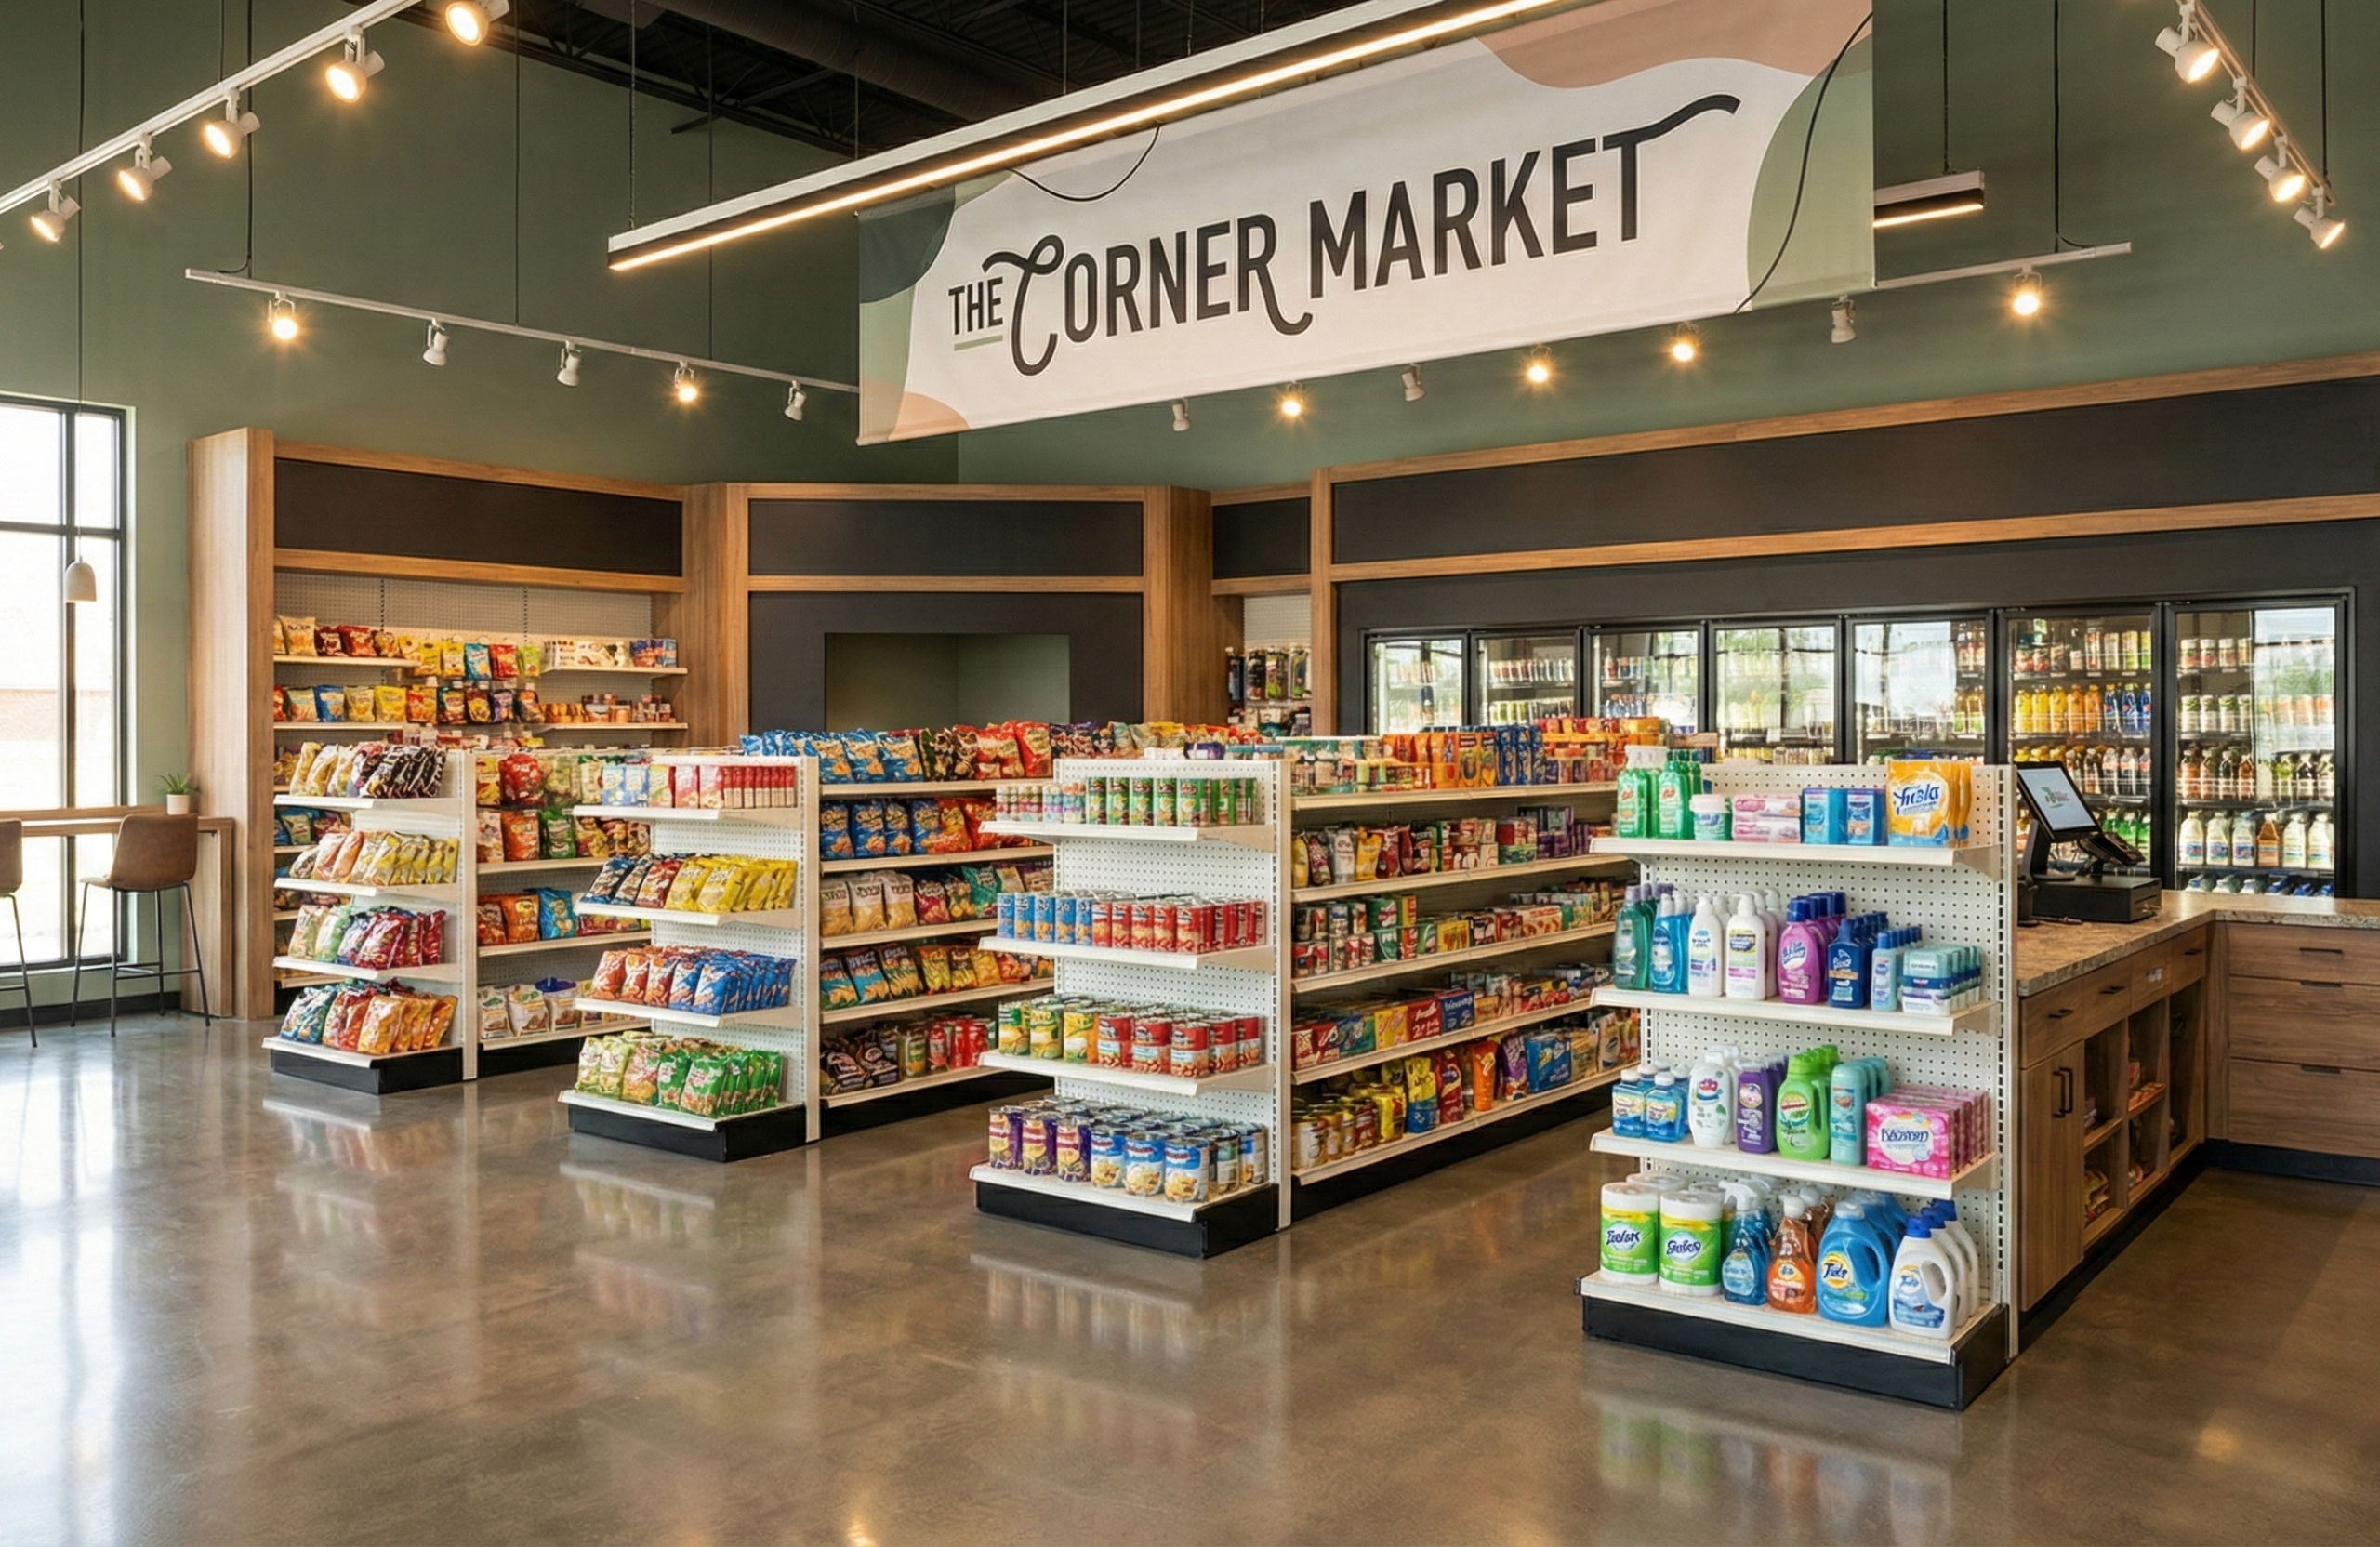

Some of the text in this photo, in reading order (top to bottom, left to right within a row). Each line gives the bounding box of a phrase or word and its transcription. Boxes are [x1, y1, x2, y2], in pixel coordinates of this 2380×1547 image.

[948, 94, 1741, 377] THE CORNER MARKET
